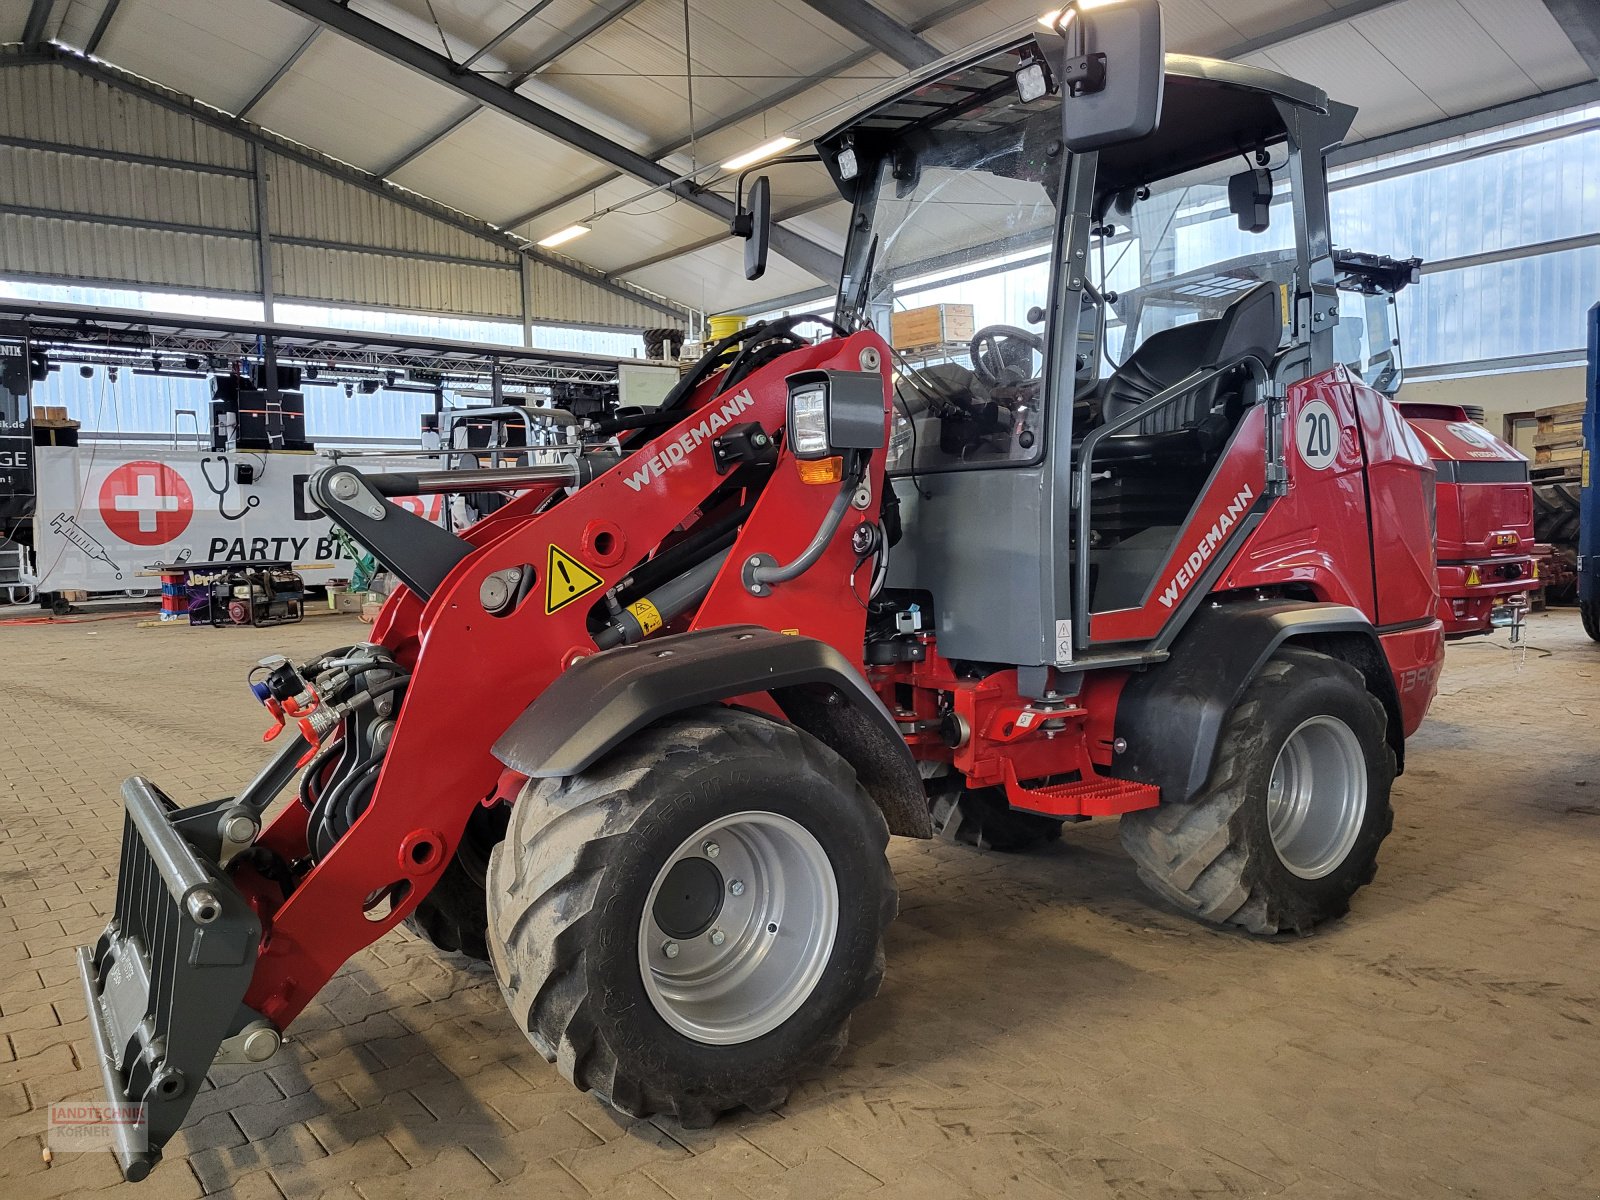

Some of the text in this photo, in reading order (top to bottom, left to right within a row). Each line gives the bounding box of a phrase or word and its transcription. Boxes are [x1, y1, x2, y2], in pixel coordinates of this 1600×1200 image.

[623, 388, 755, 492] WEIDEMANN
[1305, 413, 1331, 457] 20
[208, 537, 309, 561] PARTY
[1158, 483, 1254, 608] WEIDEMANN
